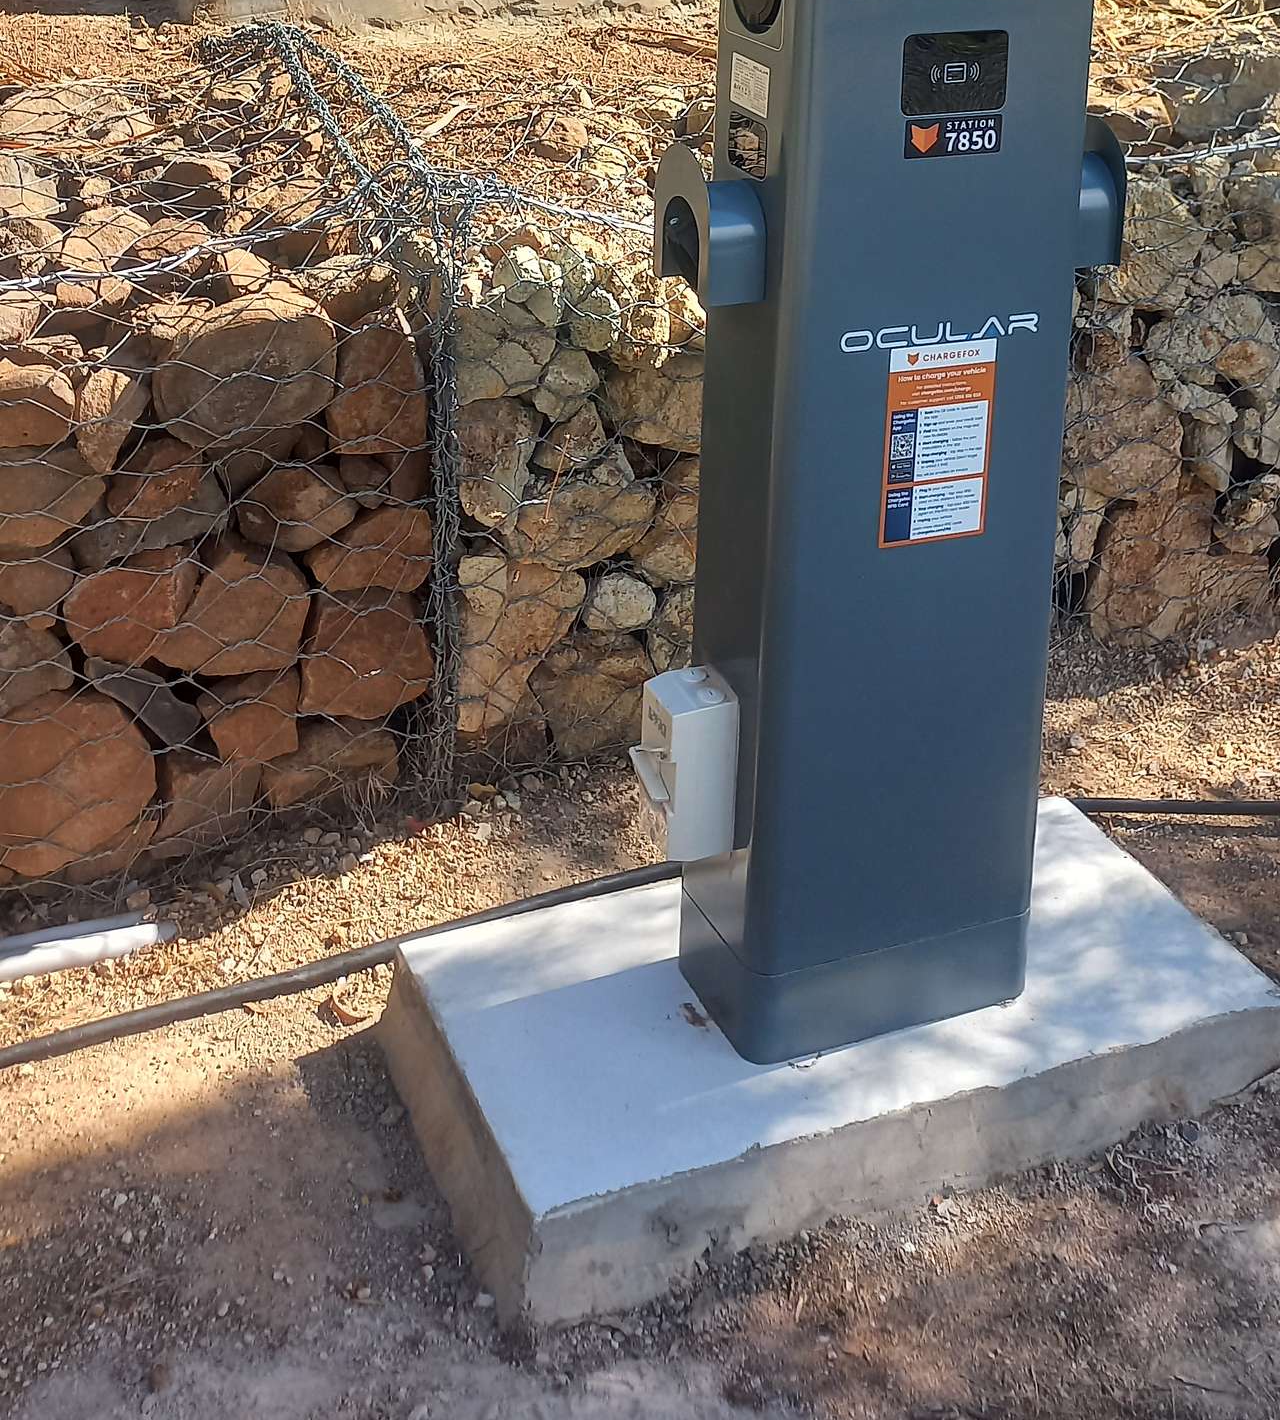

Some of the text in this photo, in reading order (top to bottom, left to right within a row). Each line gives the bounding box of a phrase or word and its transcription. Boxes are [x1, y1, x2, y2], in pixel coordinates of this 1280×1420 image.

[946, 119, 995, 130] STATION
[945, 129, 997, 152] 7850
[840, 313, 1039, 353] OCULAR
[923, 349, 981, 362] CHARGEFOX
[922, 371, 946, 381] charge
[946, 370, 962, 379] your
[963, 366, 987, 375] vehicle
